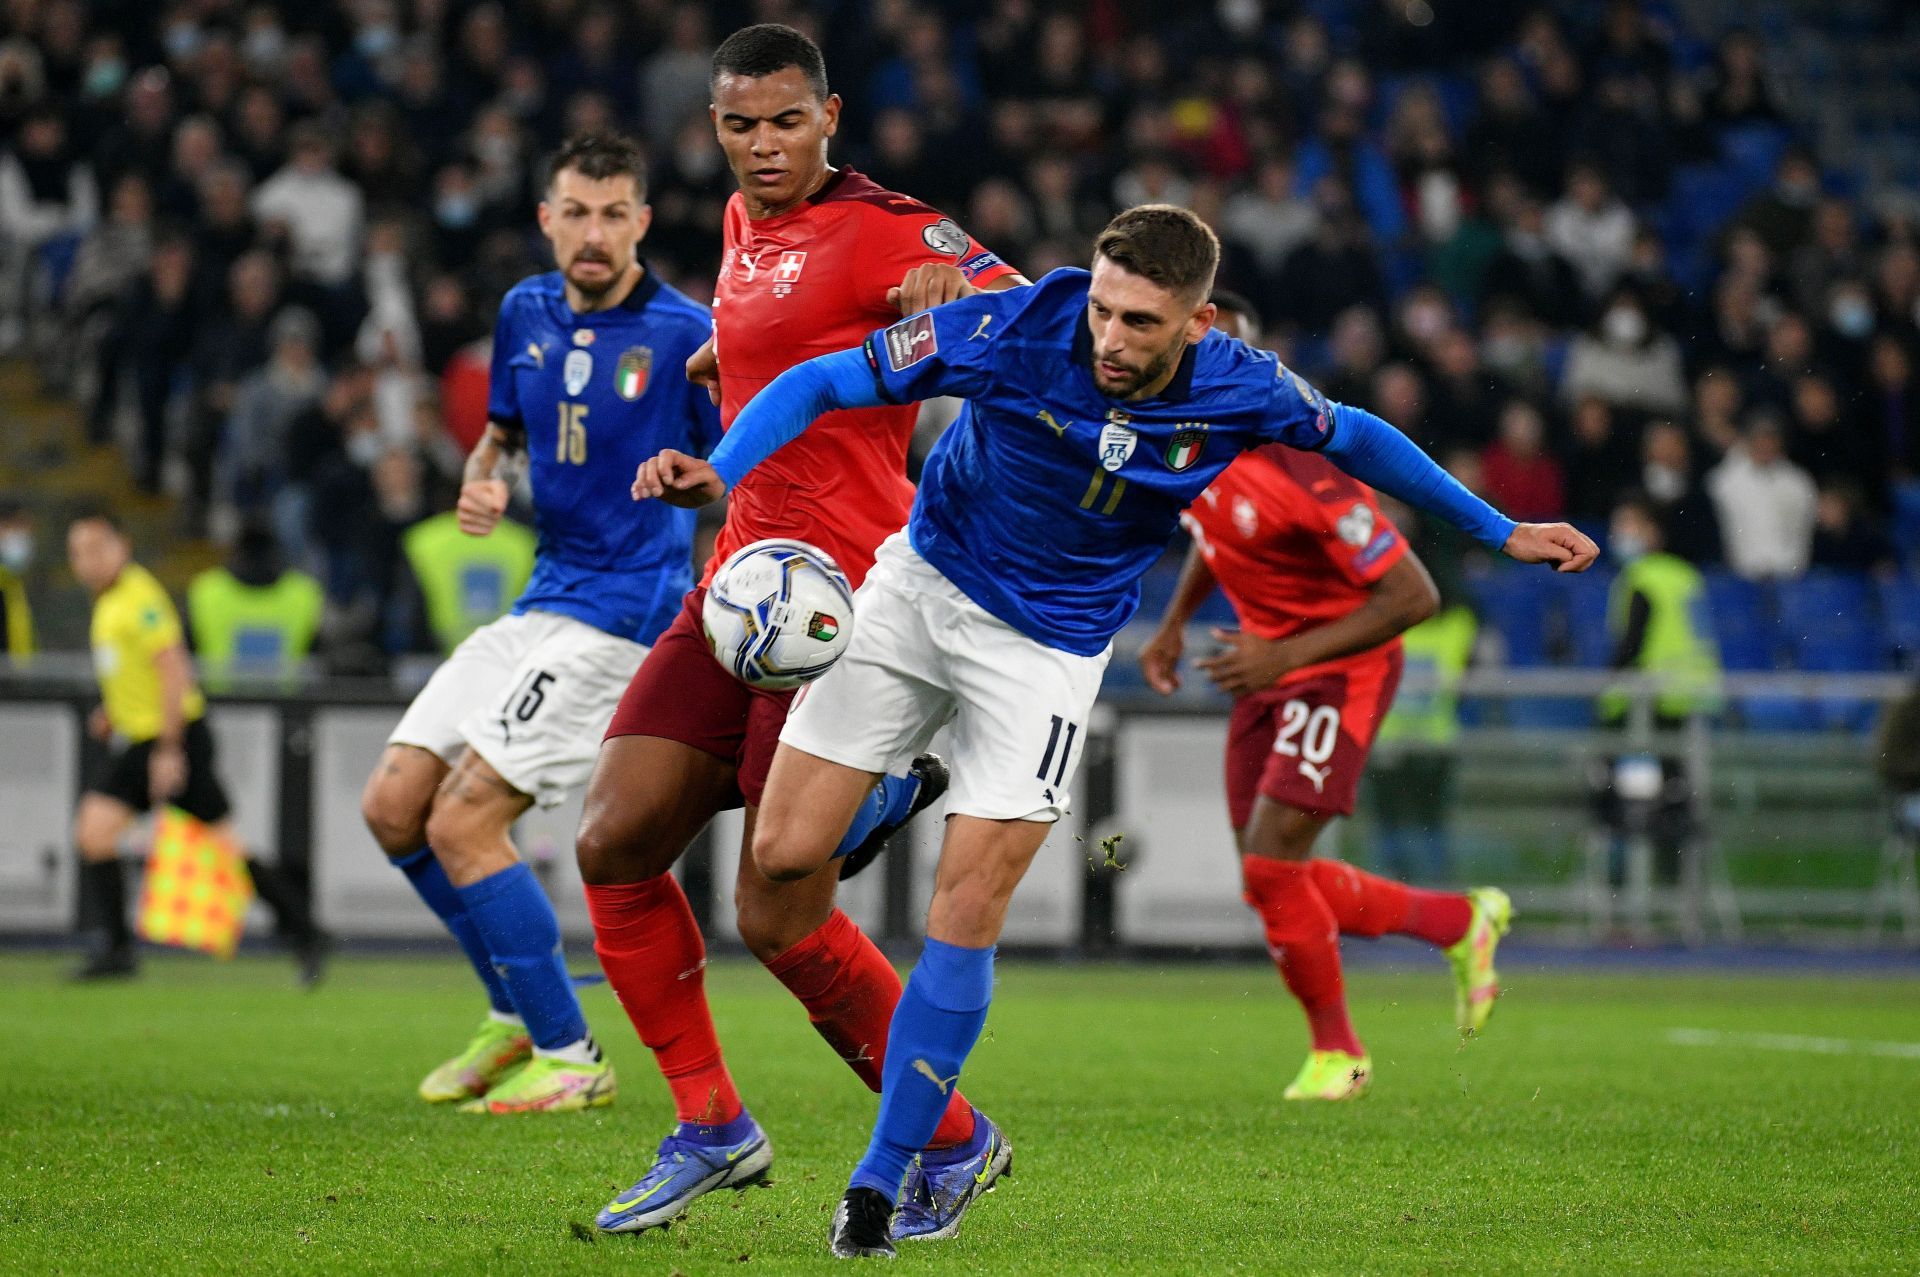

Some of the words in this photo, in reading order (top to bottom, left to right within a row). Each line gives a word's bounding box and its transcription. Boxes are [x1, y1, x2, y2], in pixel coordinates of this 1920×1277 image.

[556, 402, 588, 465] 15
[1079, 467, 1127, 516] 11
[502, 669, 556, 722] 15
[1036, 713, 1077, 788] 11
[1273, 699, 1340, 763] 20
